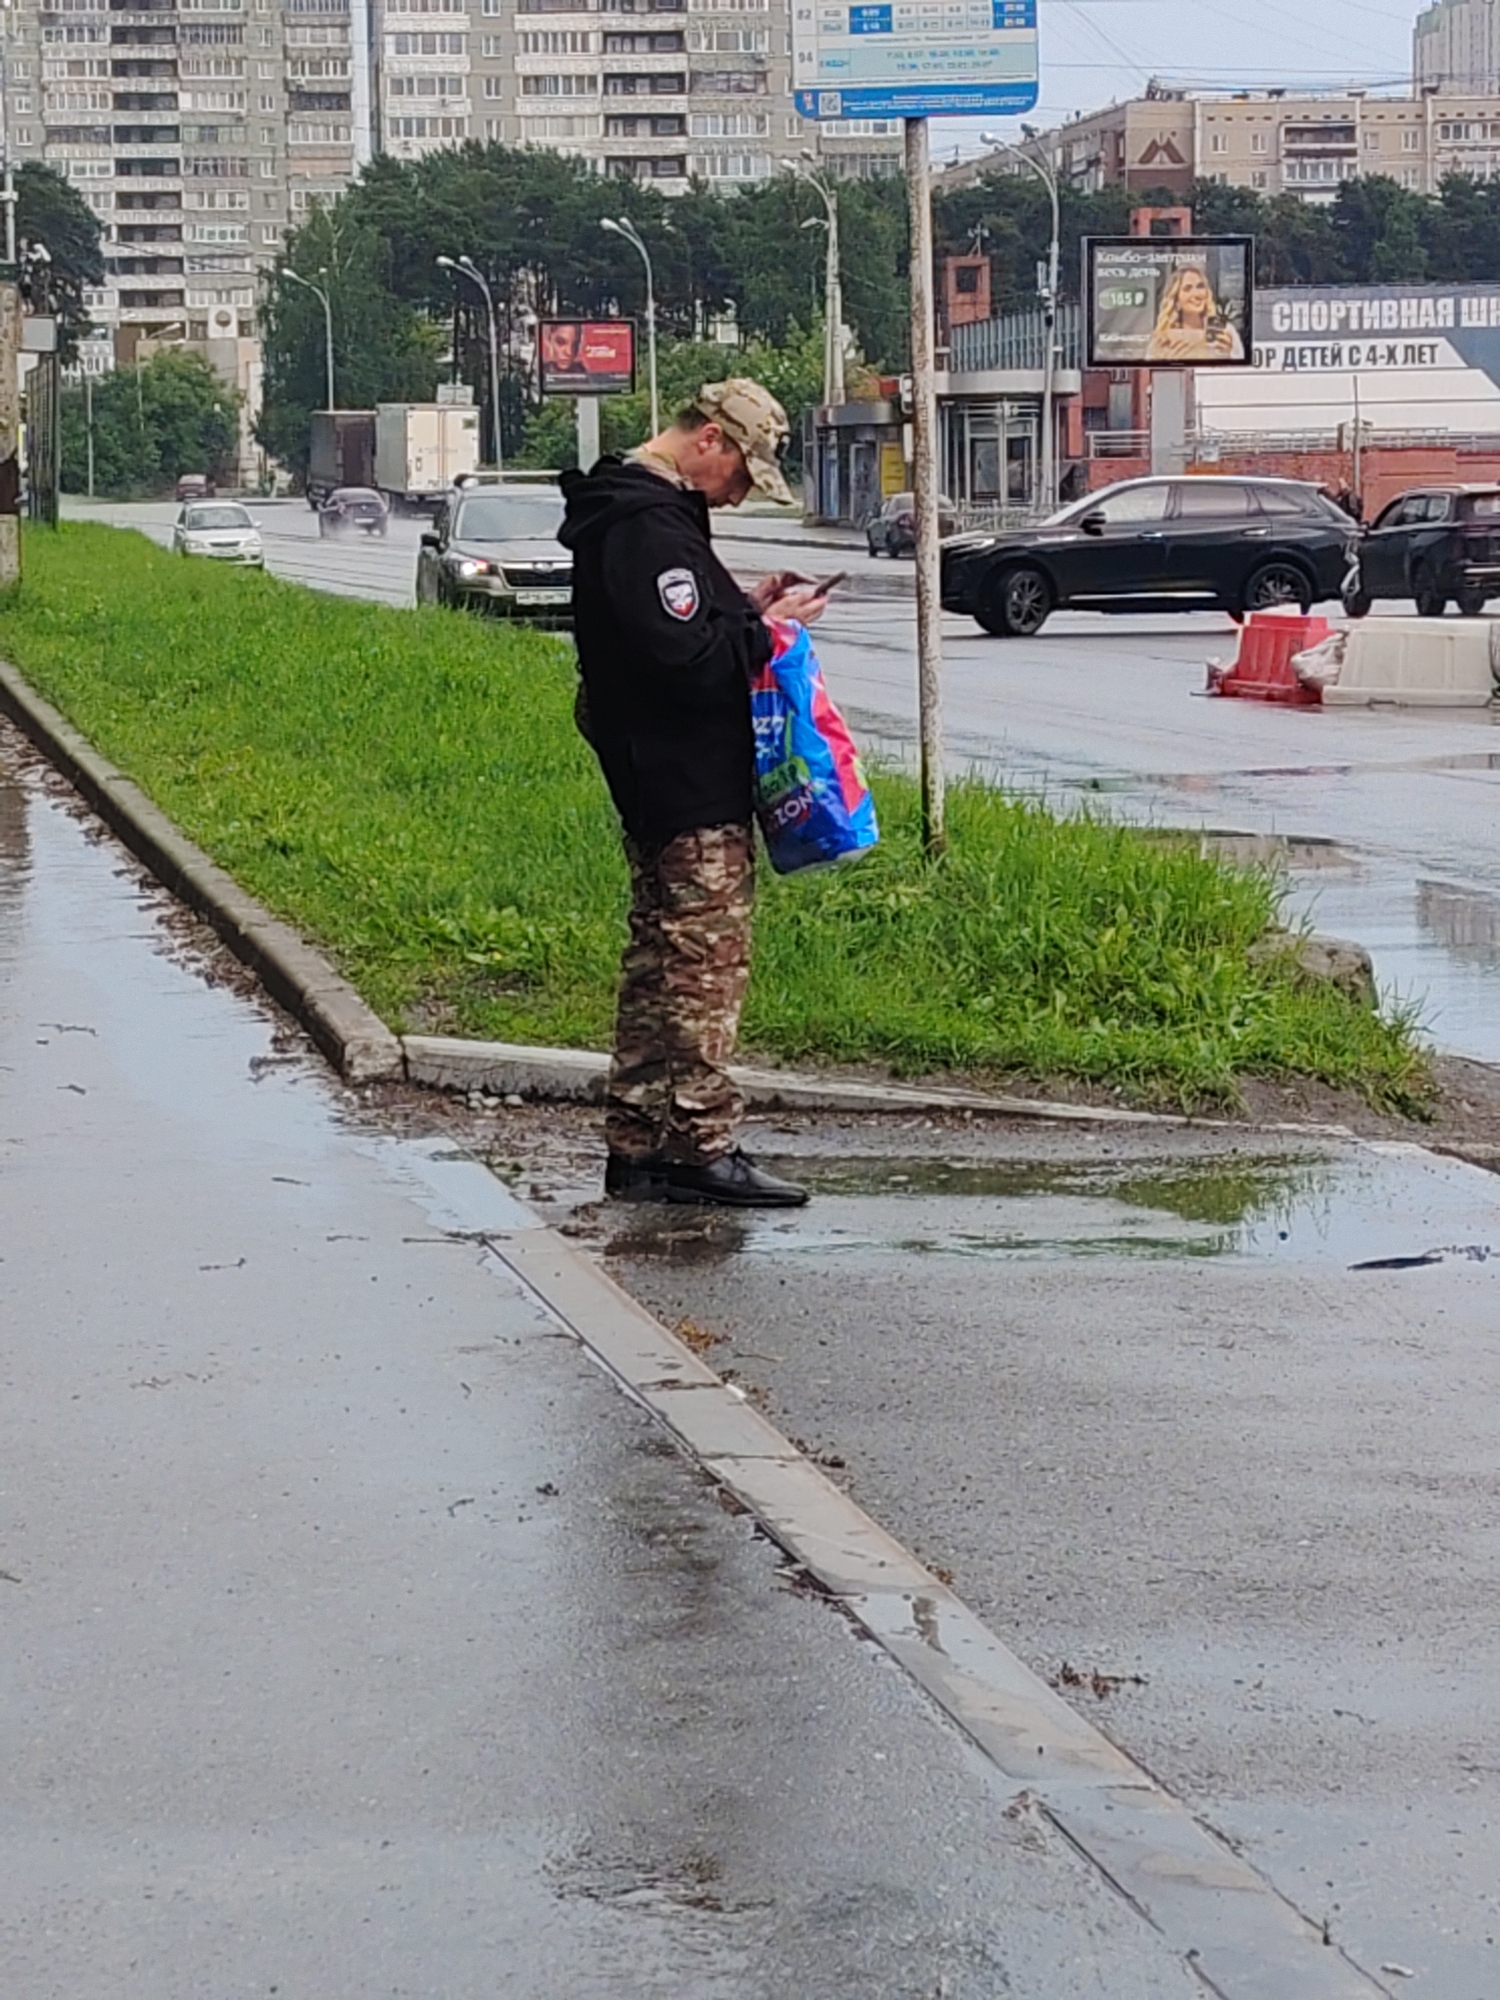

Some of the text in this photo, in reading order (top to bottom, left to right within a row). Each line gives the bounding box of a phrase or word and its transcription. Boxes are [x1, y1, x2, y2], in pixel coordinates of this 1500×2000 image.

[1272, 298, 1454, 332] СПОРТИВНАЯ
[1282, 343, 1342, 371] ДЕТЕЙ
[1403, 344, 1438, 365] ЛЕТ
